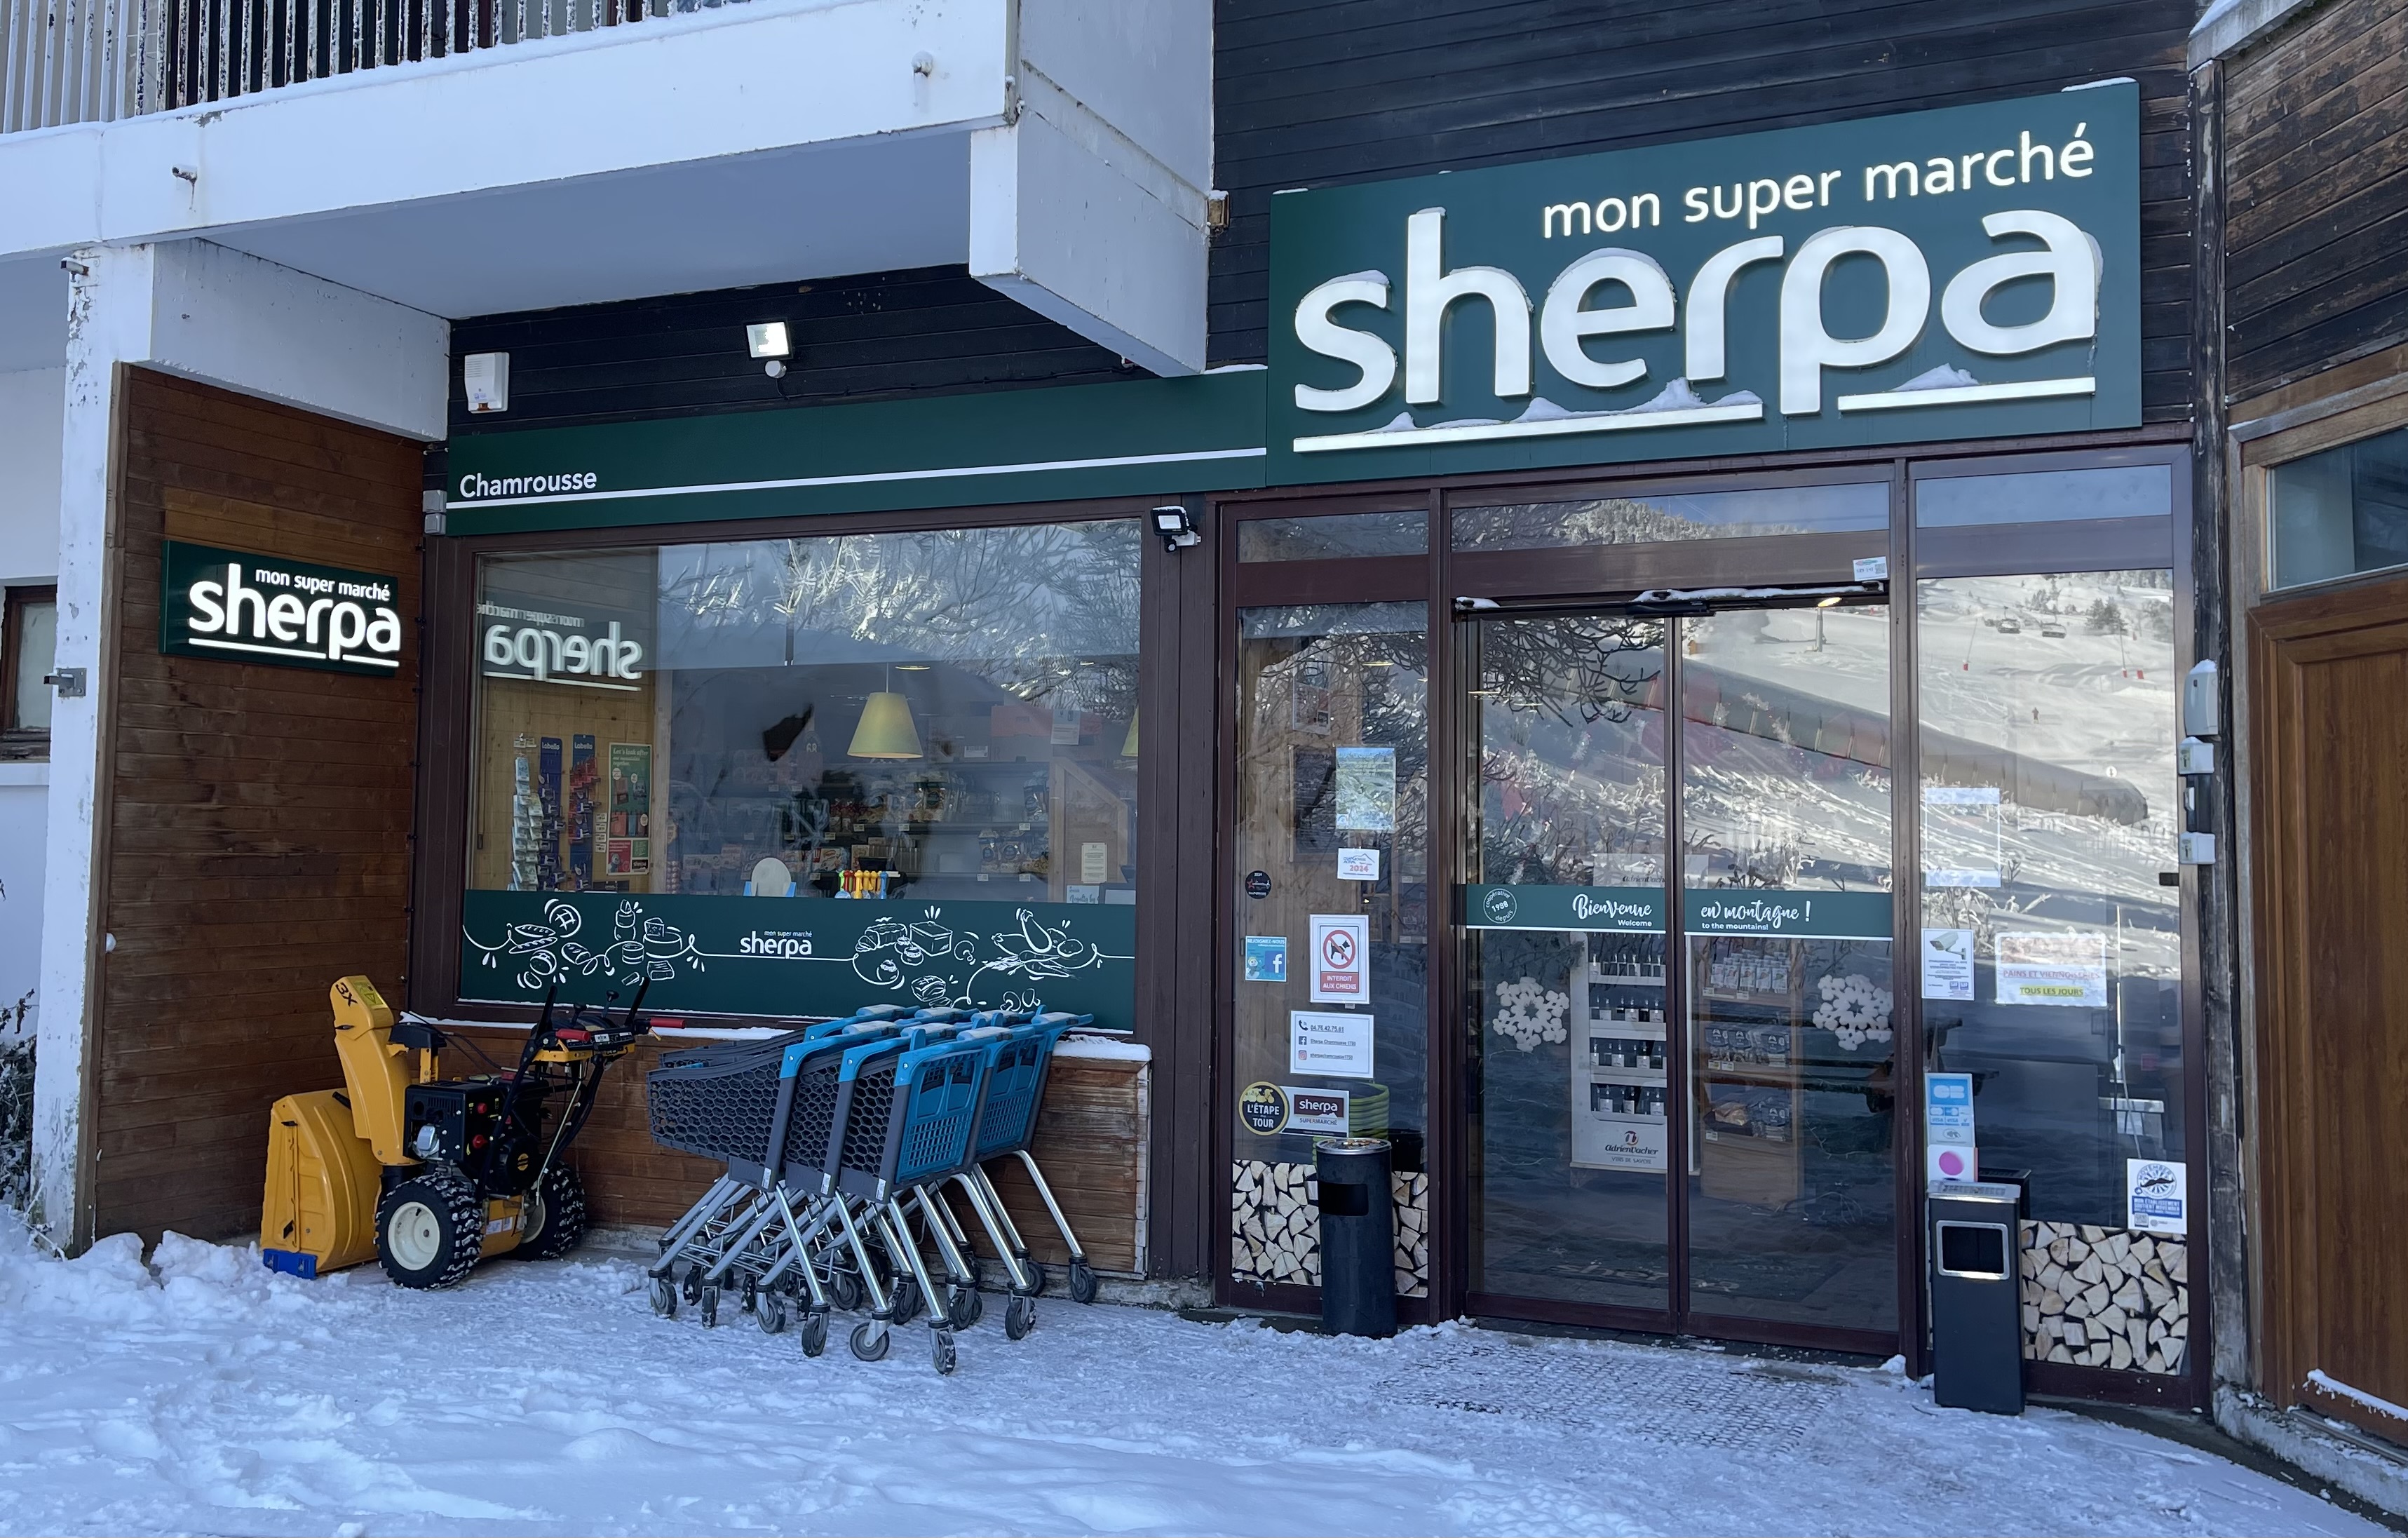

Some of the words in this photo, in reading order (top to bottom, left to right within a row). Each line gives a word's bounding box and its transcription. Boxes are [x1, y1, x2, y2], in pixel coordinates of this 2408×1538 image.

[1544, 193, 1660, 238] mon
[1684, 170, 1842, 229] super
[1866, 123, 2095, 201] marché
[1294, 208, 2097, 415] sherpa
[459, 471, 597, 498] Chamrousse
[255, 569, 290, 586] mon
[293, 575, 335, 595] super
[338, 582, 391, 601] marché
[189, 563, 401, 660] sherpa
[1491, 900, 1509, 912] 1988
[1495, 910, 1513, 922] depuis
[1724, 899, 1800, 929] montagne
[740, 930, 812, 959] sherpa
[2003, 970, 2027, 978] PAINS
[2029, 971, 2038, 979] ET
[335, 983, 358, 1007] 3X
[1247, 1103, 1280, 1116] L'ÉTAPE
[1299, 1098, 1339, 1113] sherpa
[1252, 1118, 1274, 1128] TOUR
[1299, 1117, 1338, 1126] SUPERMARCHÉ
